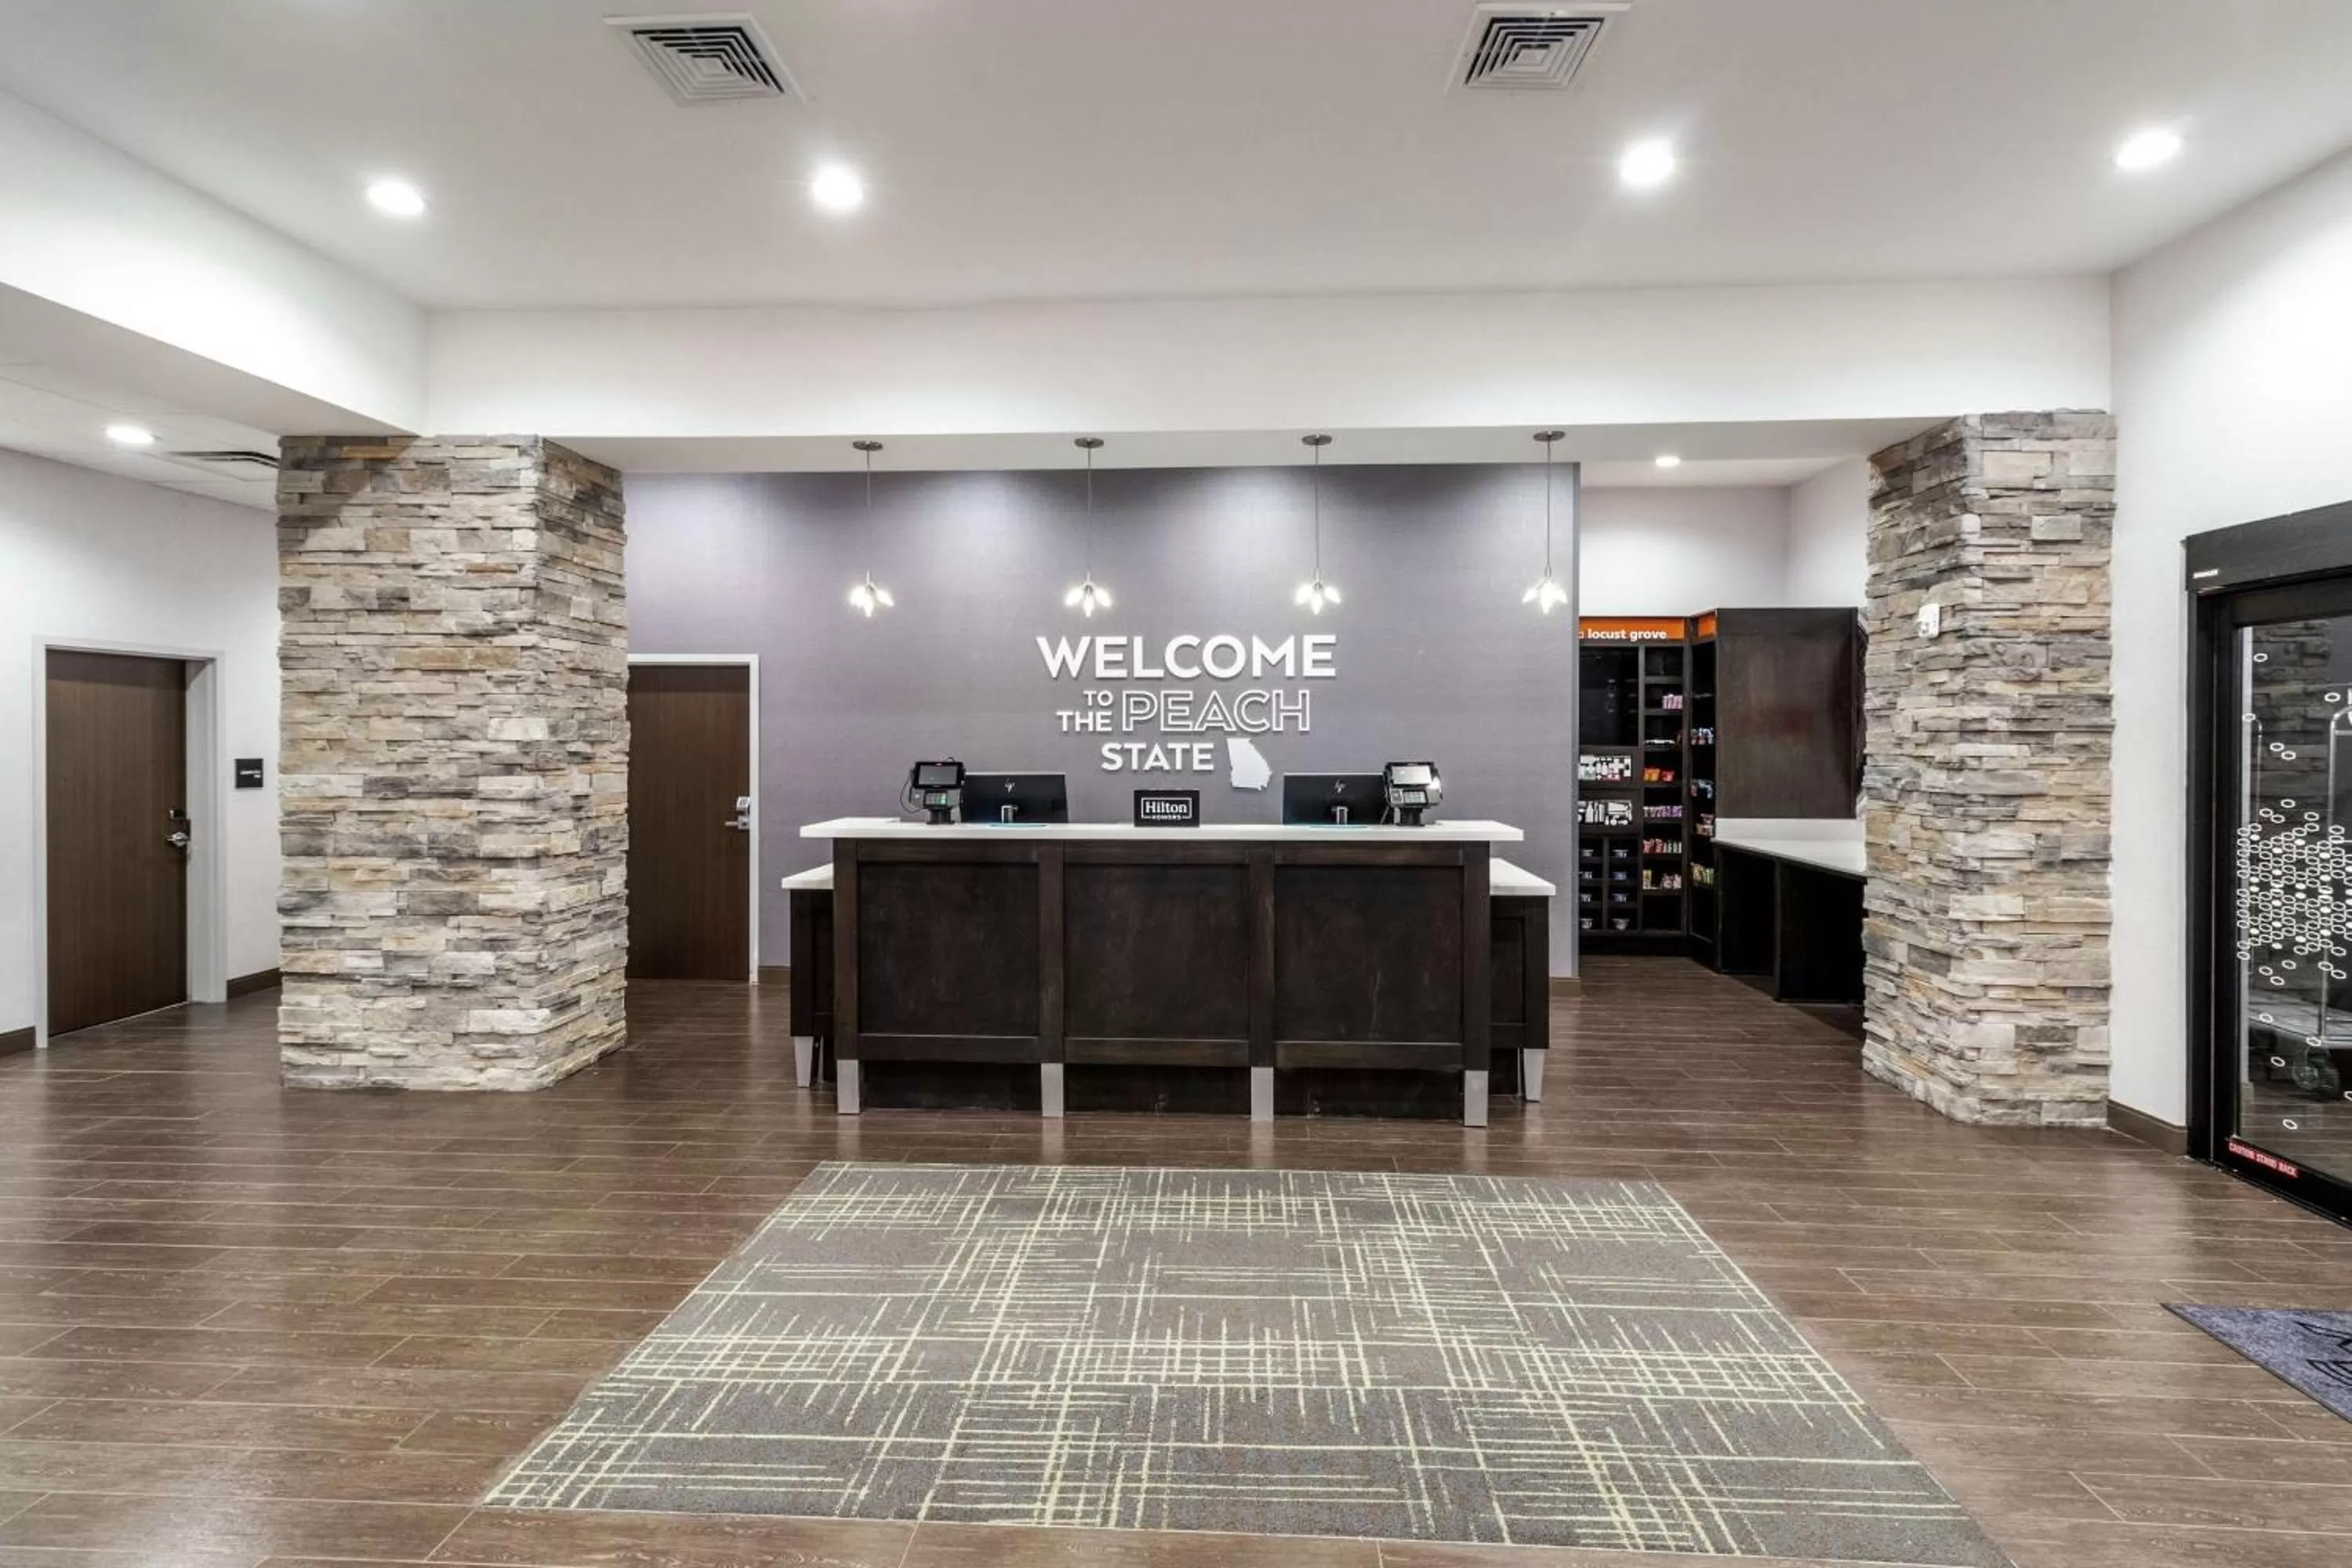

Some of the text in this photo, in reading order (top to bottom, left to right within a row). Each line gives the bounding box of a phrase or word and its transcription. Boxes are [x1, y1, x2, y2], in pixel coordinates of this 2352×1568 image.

[1587, 628, 1626, 639] locust
[1630, 630, 1668, 641] grove
[1036, 634, 1337, 679] WELCOME
[1083, 690, 1114, 707] TO
[1056, 689, 1311, 733] THE PEACH
[1101, 742, 1215, 771] STATE
[1145, 800, 1188, 813] Hilton
